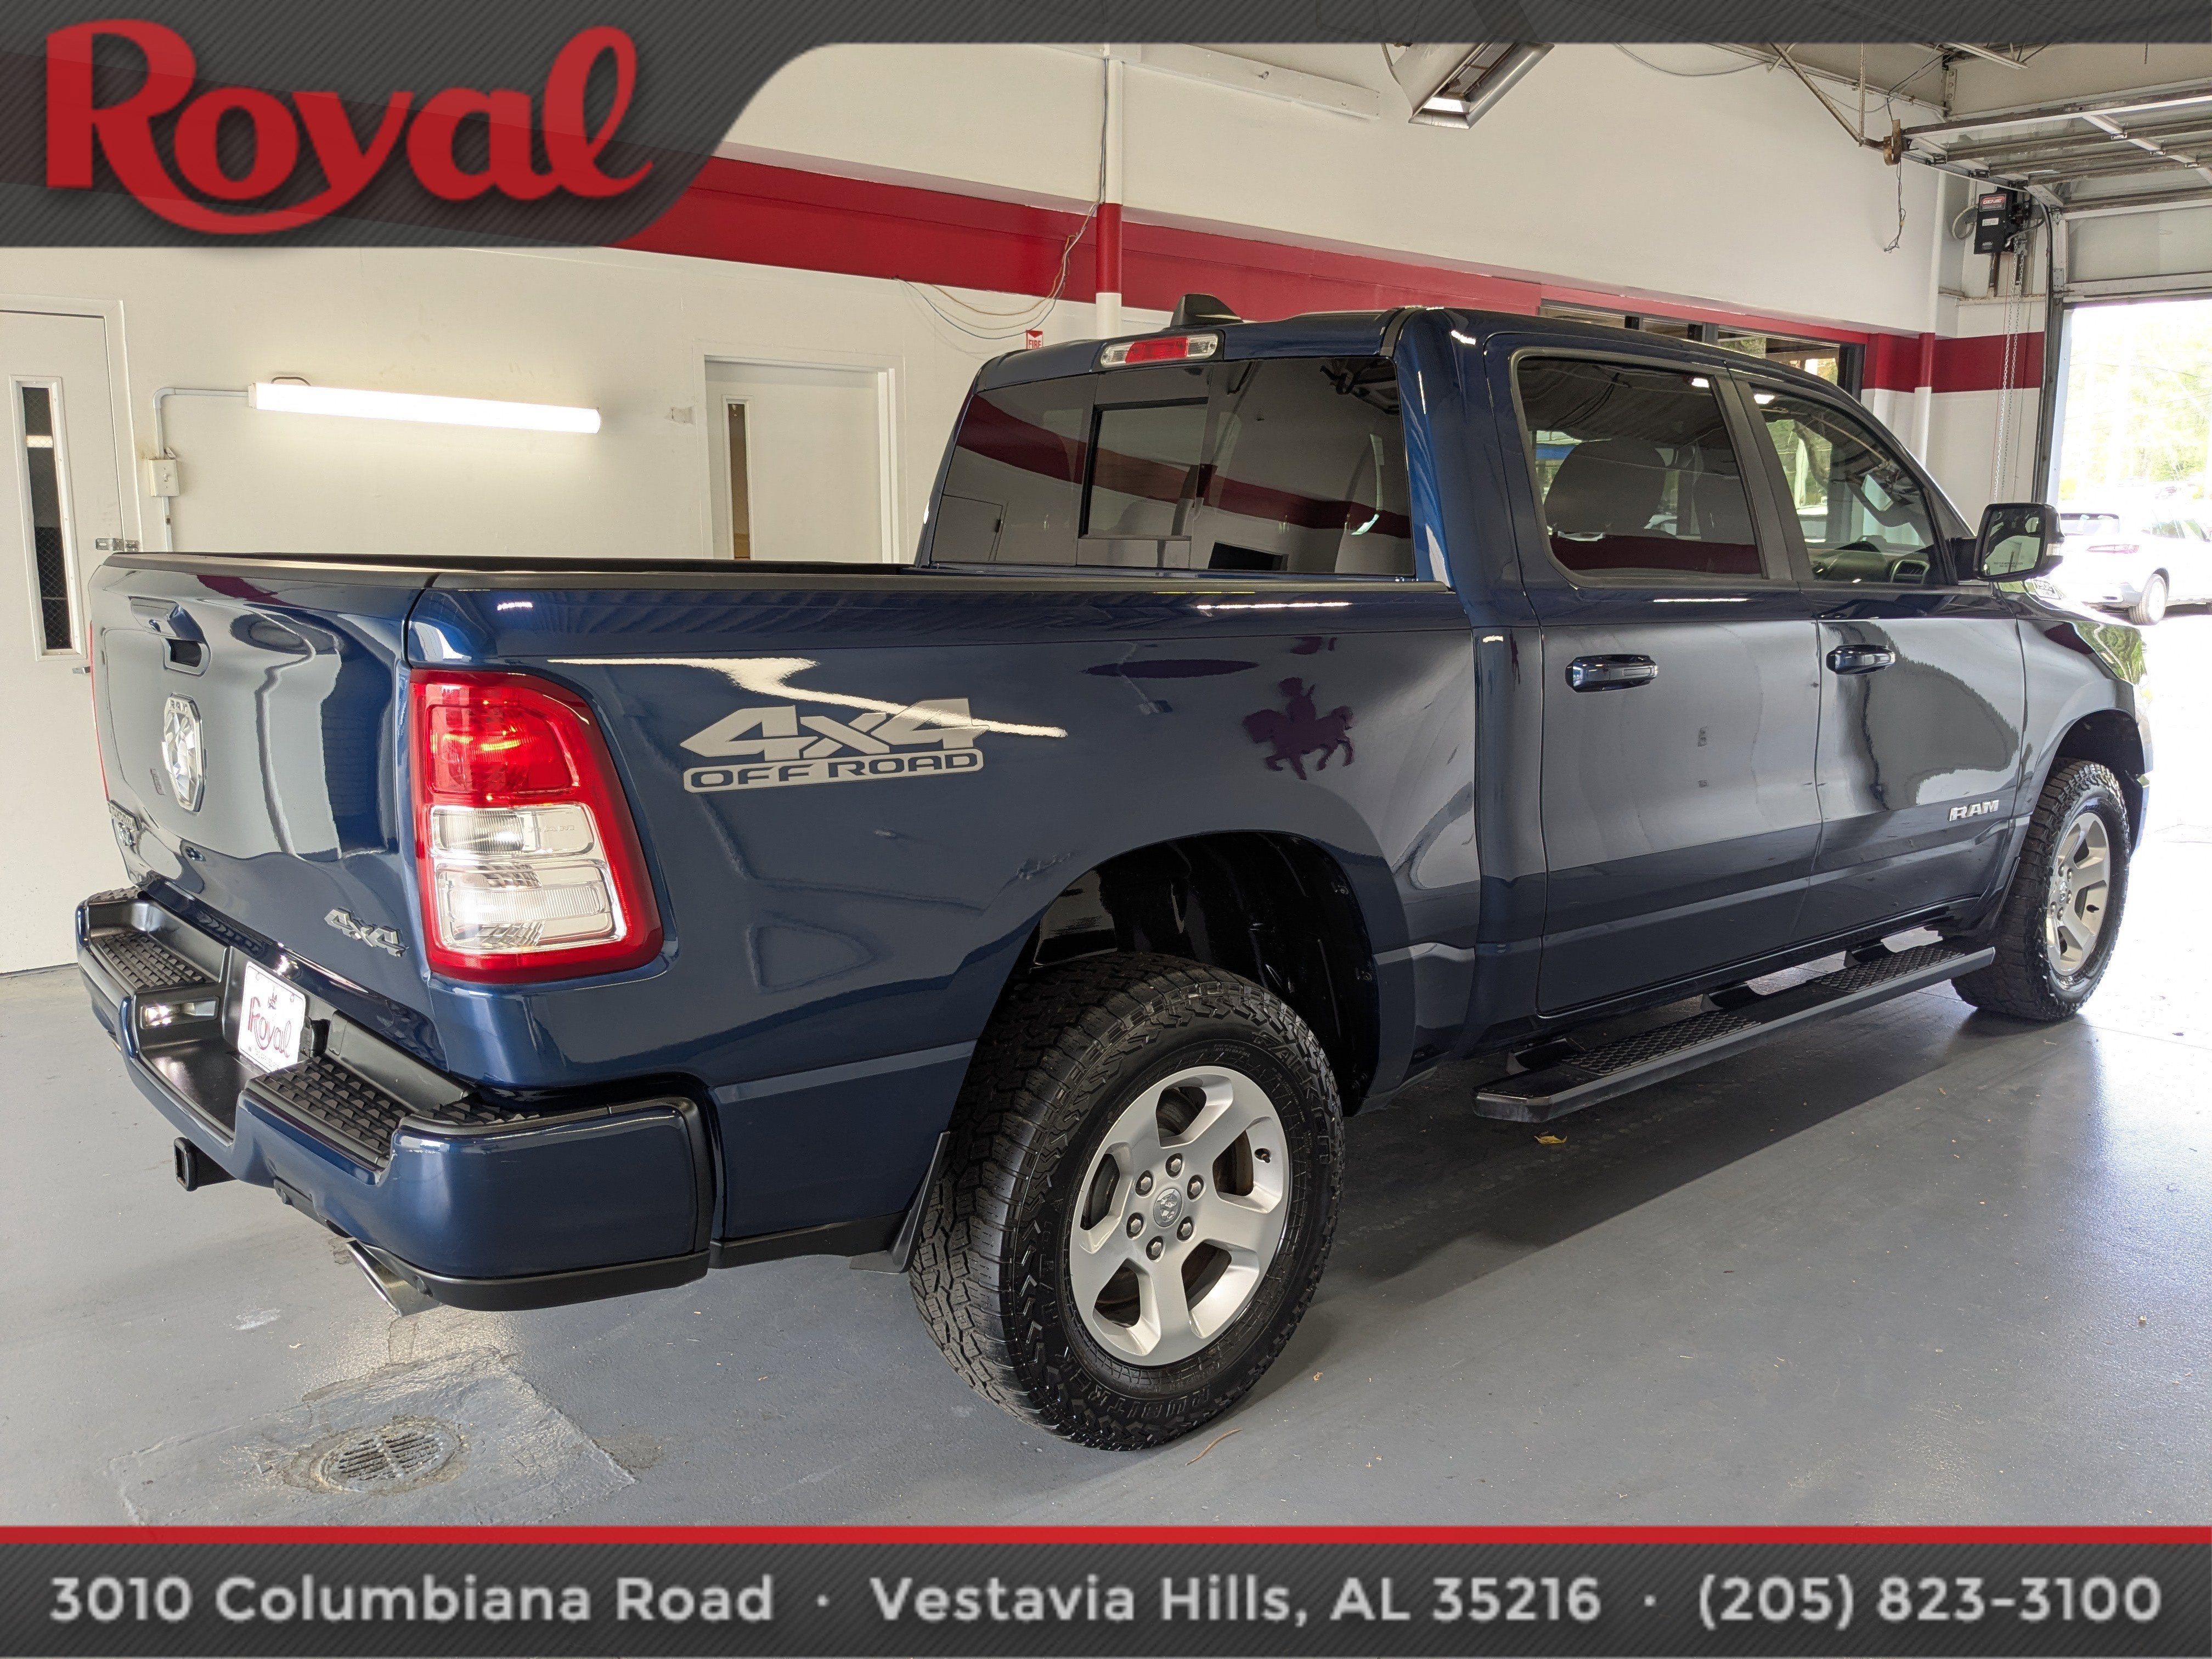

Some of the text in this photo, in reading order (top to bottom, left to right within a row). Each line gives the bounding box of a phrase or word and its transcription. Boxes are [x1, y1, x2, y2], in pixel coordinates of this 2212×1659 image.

[1028, 339, 1042, 349] FIRE
[690, 752, 979, 789] OFF ROAD
[1949, 799, 2000, 822] RAM
